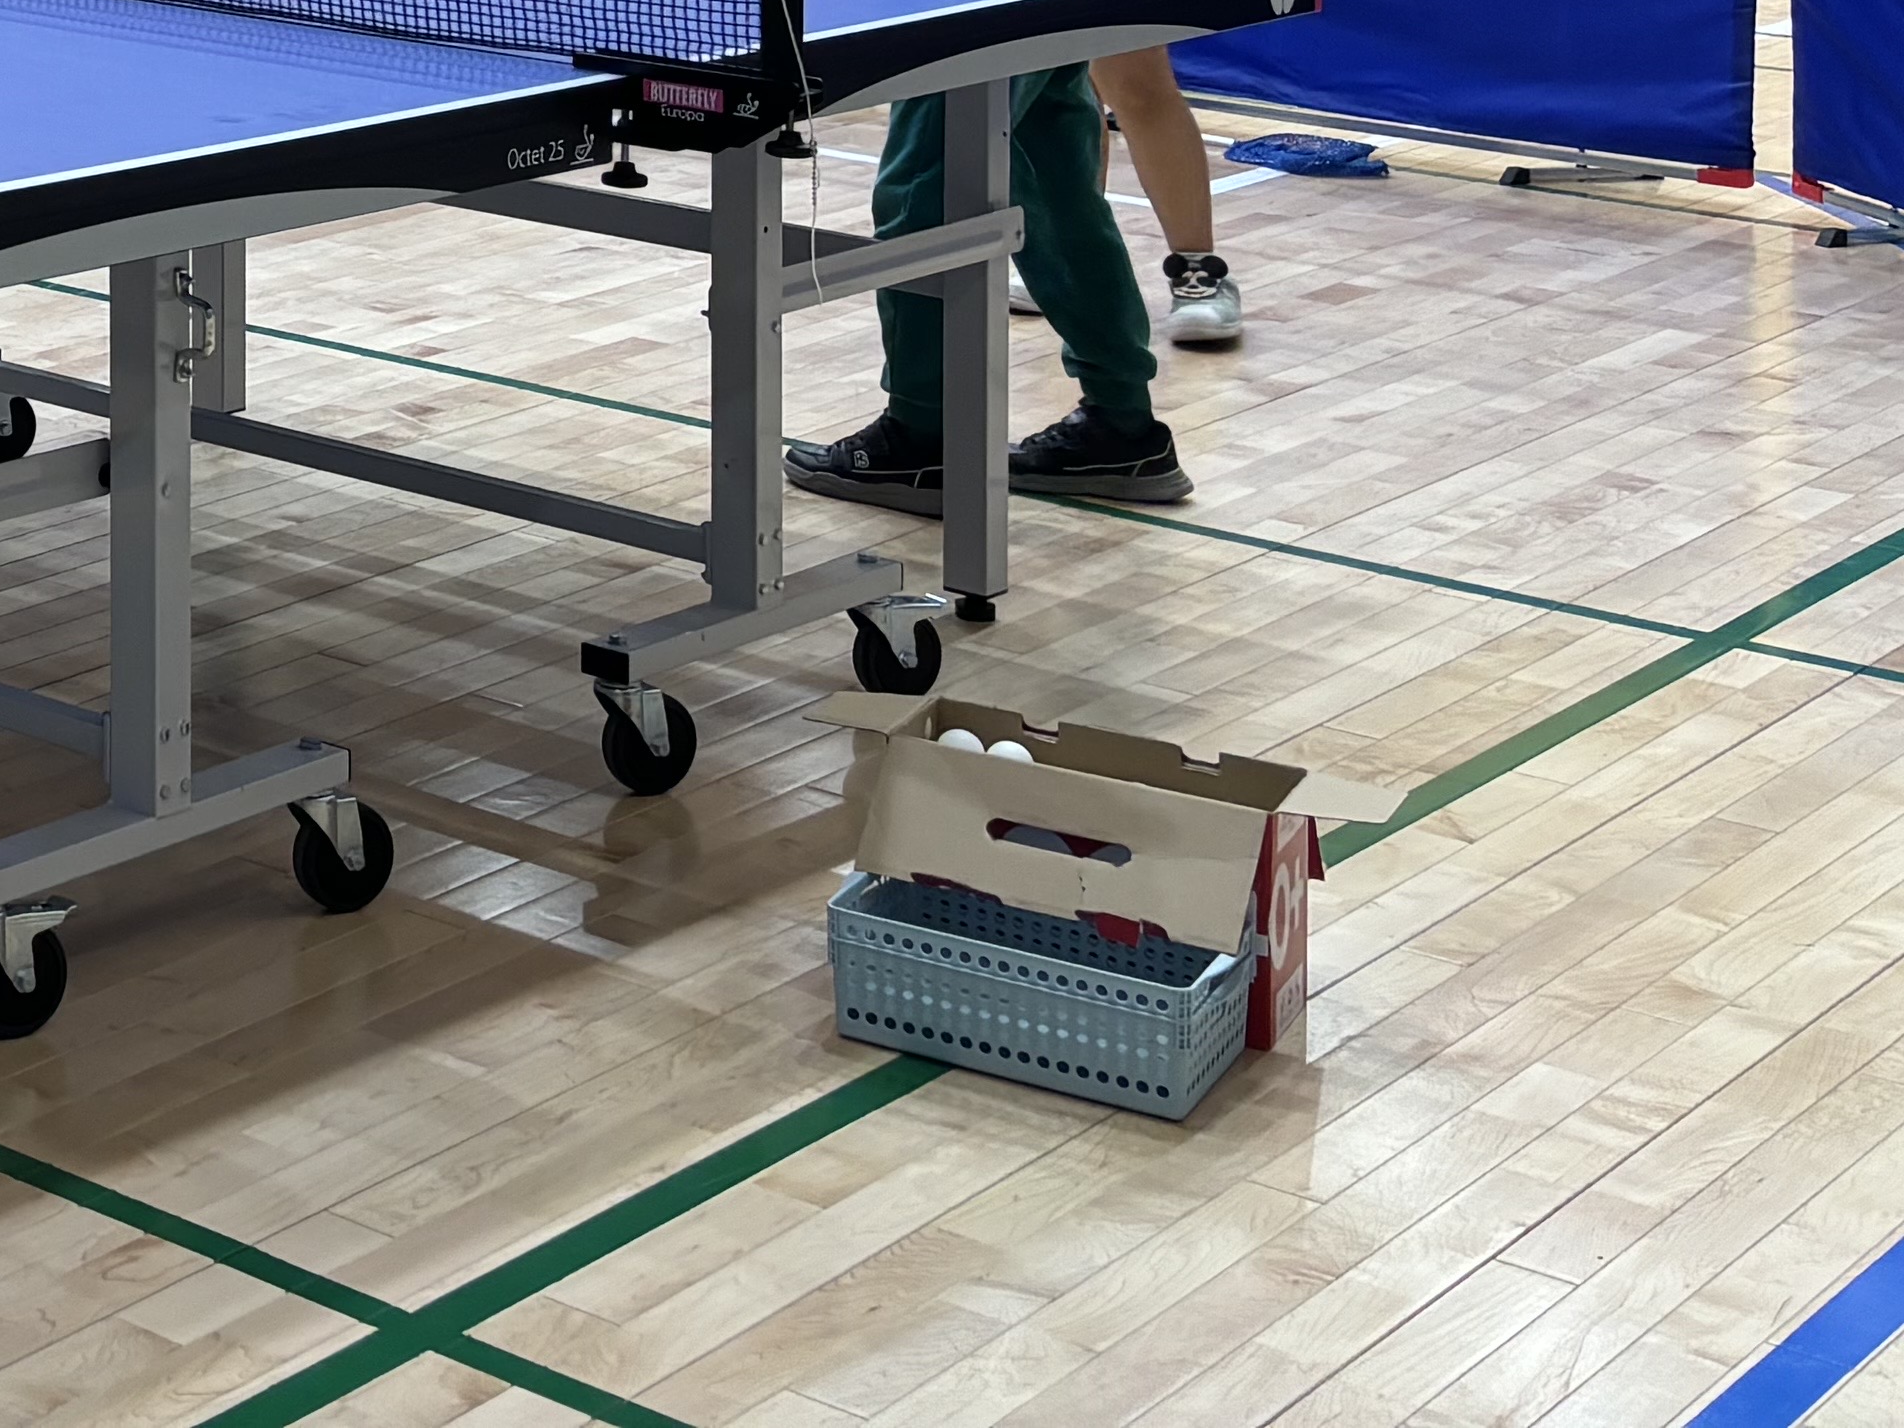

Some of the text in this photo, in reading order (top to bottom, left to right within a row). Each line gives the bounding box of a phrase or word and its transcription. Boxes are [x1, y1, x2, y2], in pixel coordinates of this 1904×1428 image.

[650, 81, 718, 109] BUTTERFLY
[661, 104, 706, 123] Europa
[507, 138, 565, 171] Octet 25
